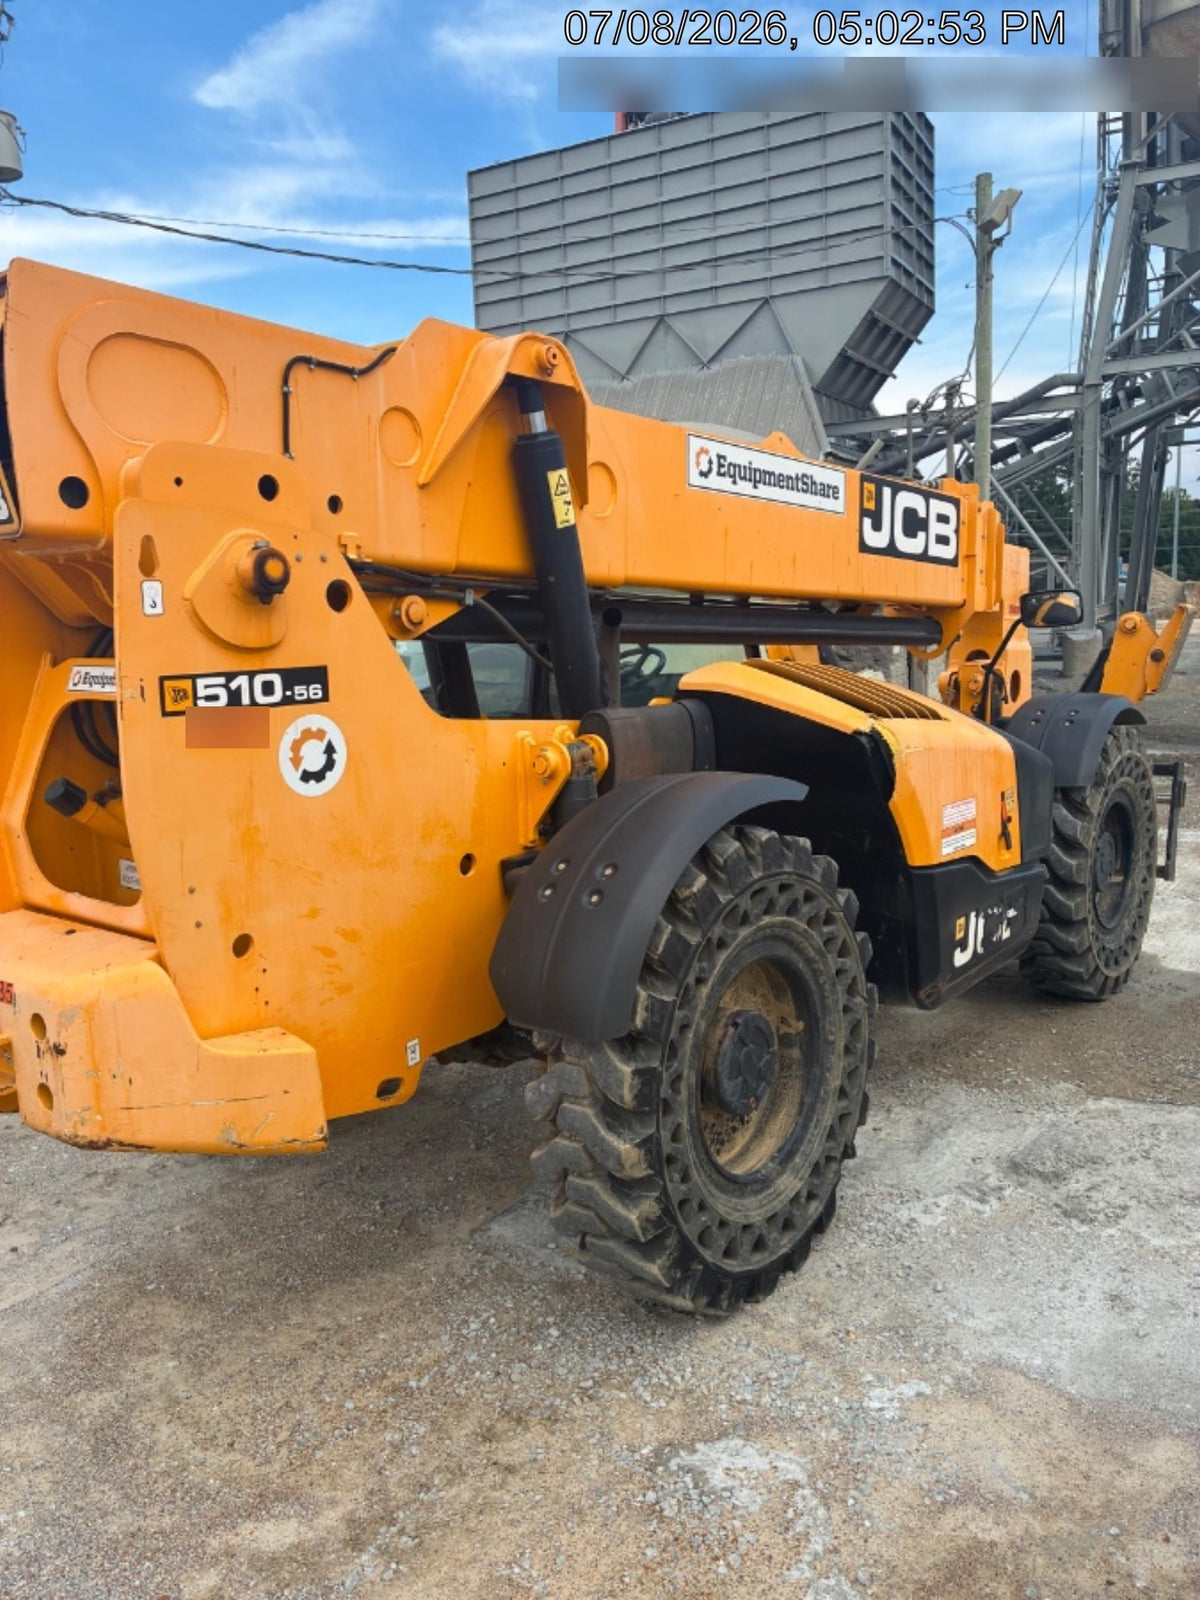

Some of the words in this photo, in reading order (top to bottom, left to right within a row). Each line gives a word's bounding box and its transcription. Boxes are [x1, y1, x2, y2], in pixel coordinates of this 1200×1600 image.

[716, 452, 840, 501] EquipmentShare
[862, 486, 958, 560] JCB
[195, 673, 323, 707] 510-56
